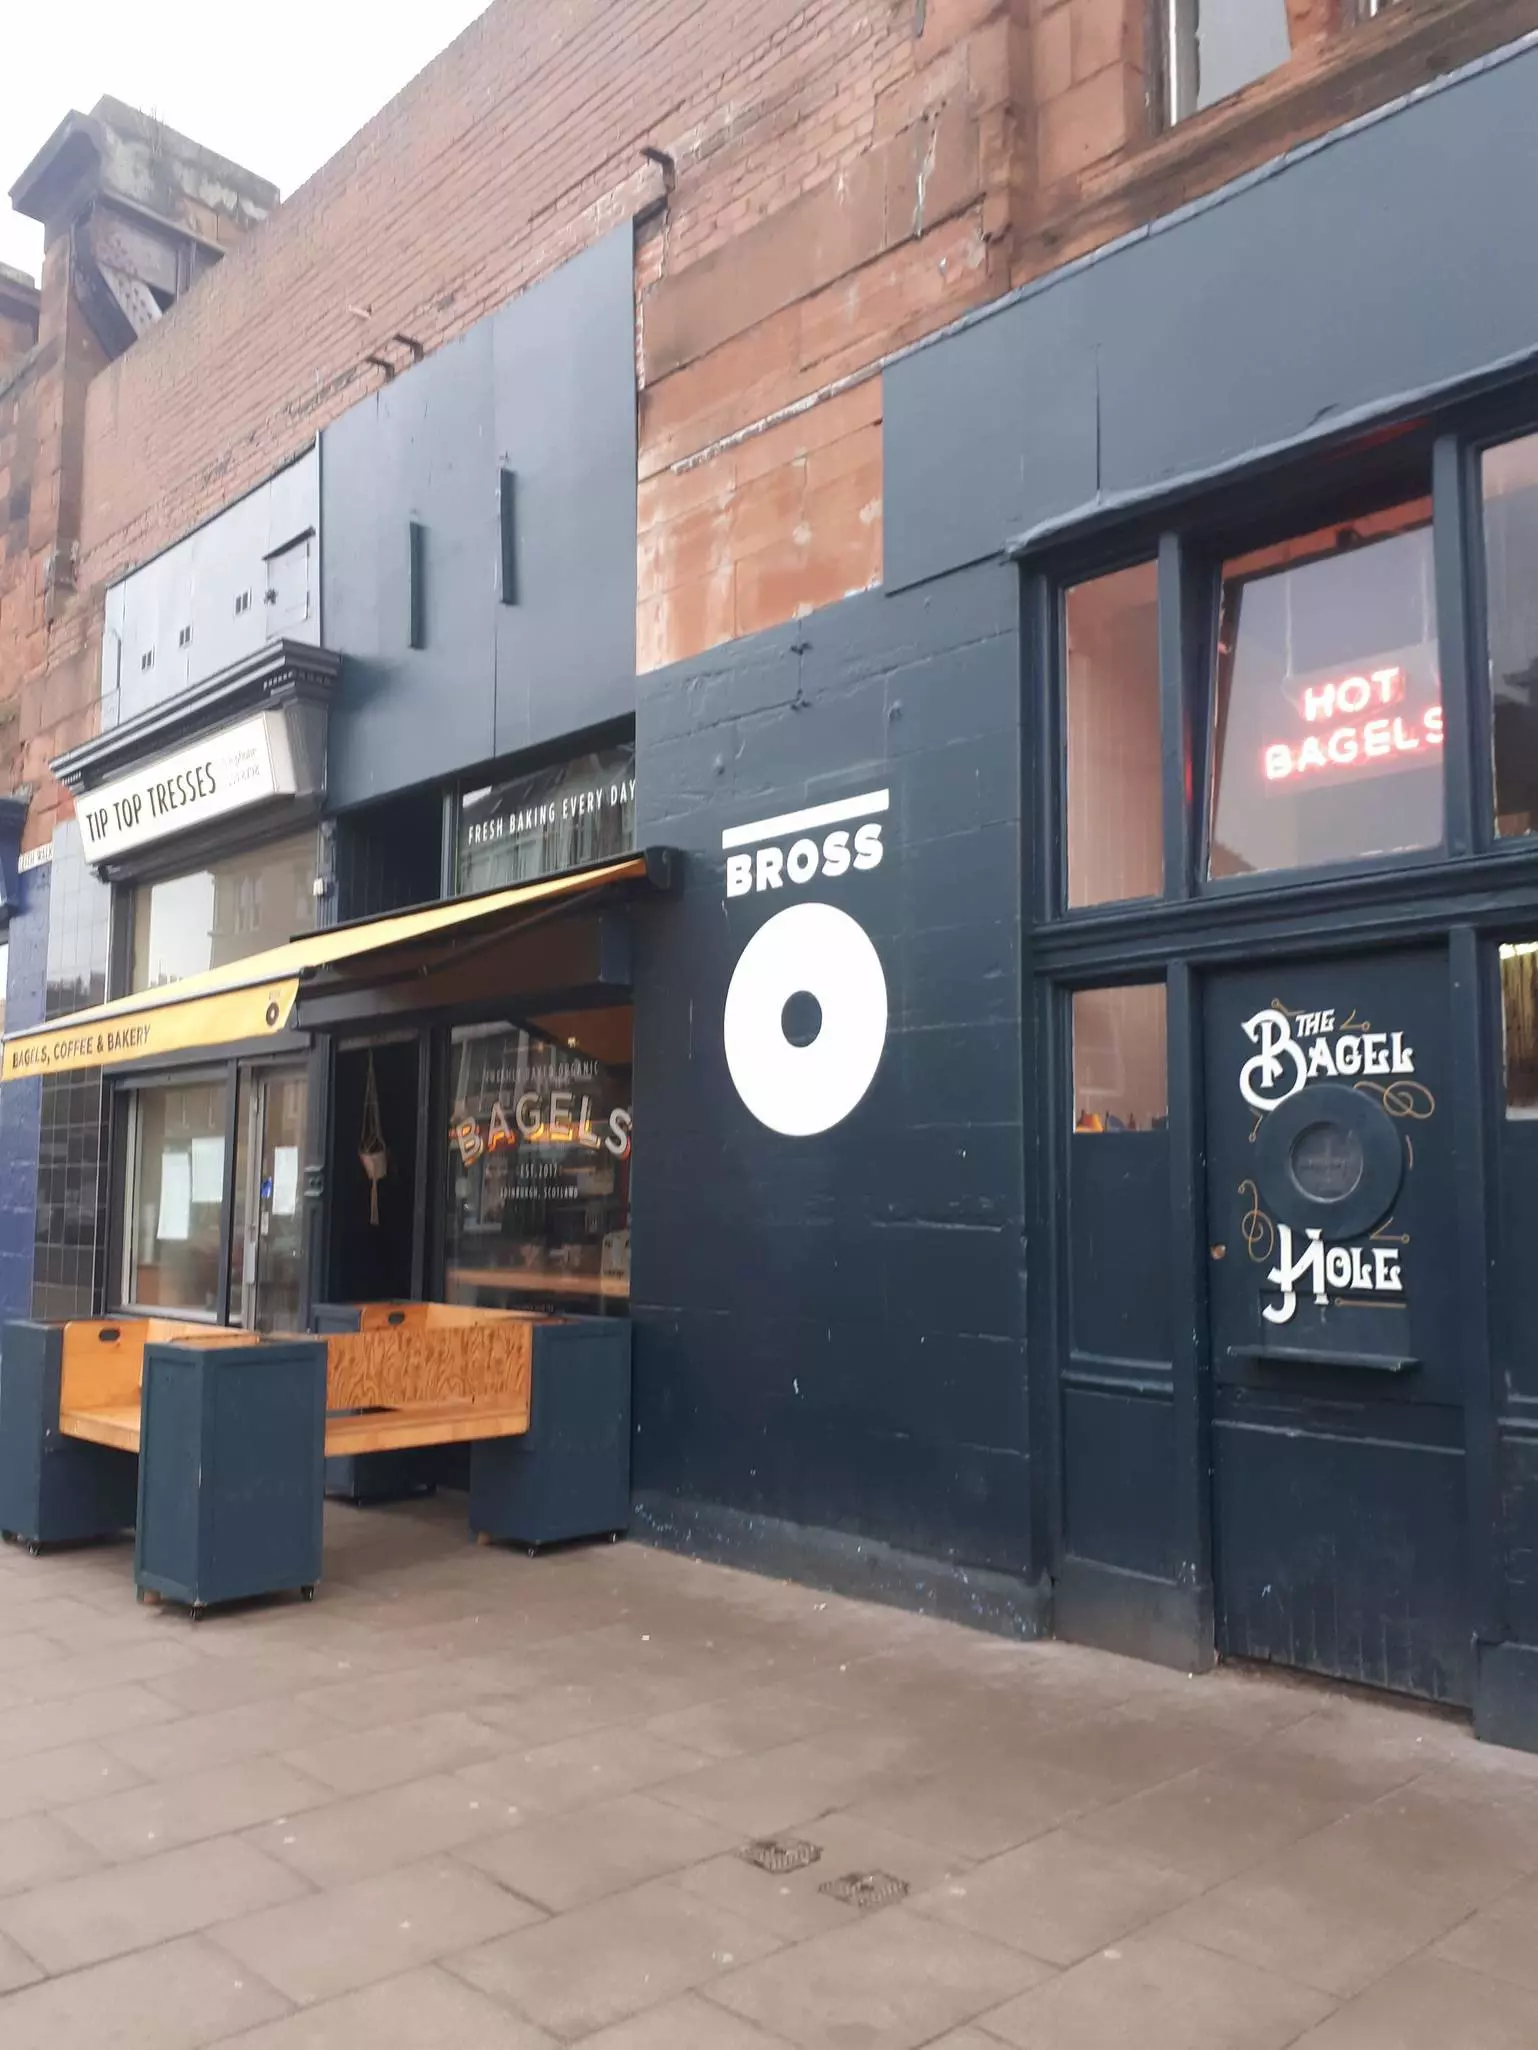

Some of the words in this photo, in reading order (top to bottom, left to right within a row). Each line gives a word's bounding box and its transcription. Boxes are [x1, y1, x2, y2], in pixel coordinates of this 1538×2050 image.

[1304, 666, 1400, 722] HOT
[1264, 706, 1444, 781] BAGELS
[86, 808, 108, 842] TIP
[113, 794, 142, 831] TOP
[147, 762, 216, 818] TRESSES
[468, 815, 504, 845] FRESH
[509, 802, 555, 833] BAKING
[562, 787, 603, 820] EVERY
[610, 779, 636, 807] DAY
[726, 823, 885, 898] BROSS
[12, 1045, 51, 1069] BAGELS,
[53, 1036, 94, 1060] COFFEE
[96, 1034, 104, 1053] &
[107, 1024, 151, 1051] BAKERY
[1239, 1008, 1415, 1112] BAGEL
[1295, 1008, 1336, 1039] THE
[456, 1091, 633, 1166] BAGELS
[1262, 1223, 1403, 1325] HOLE
